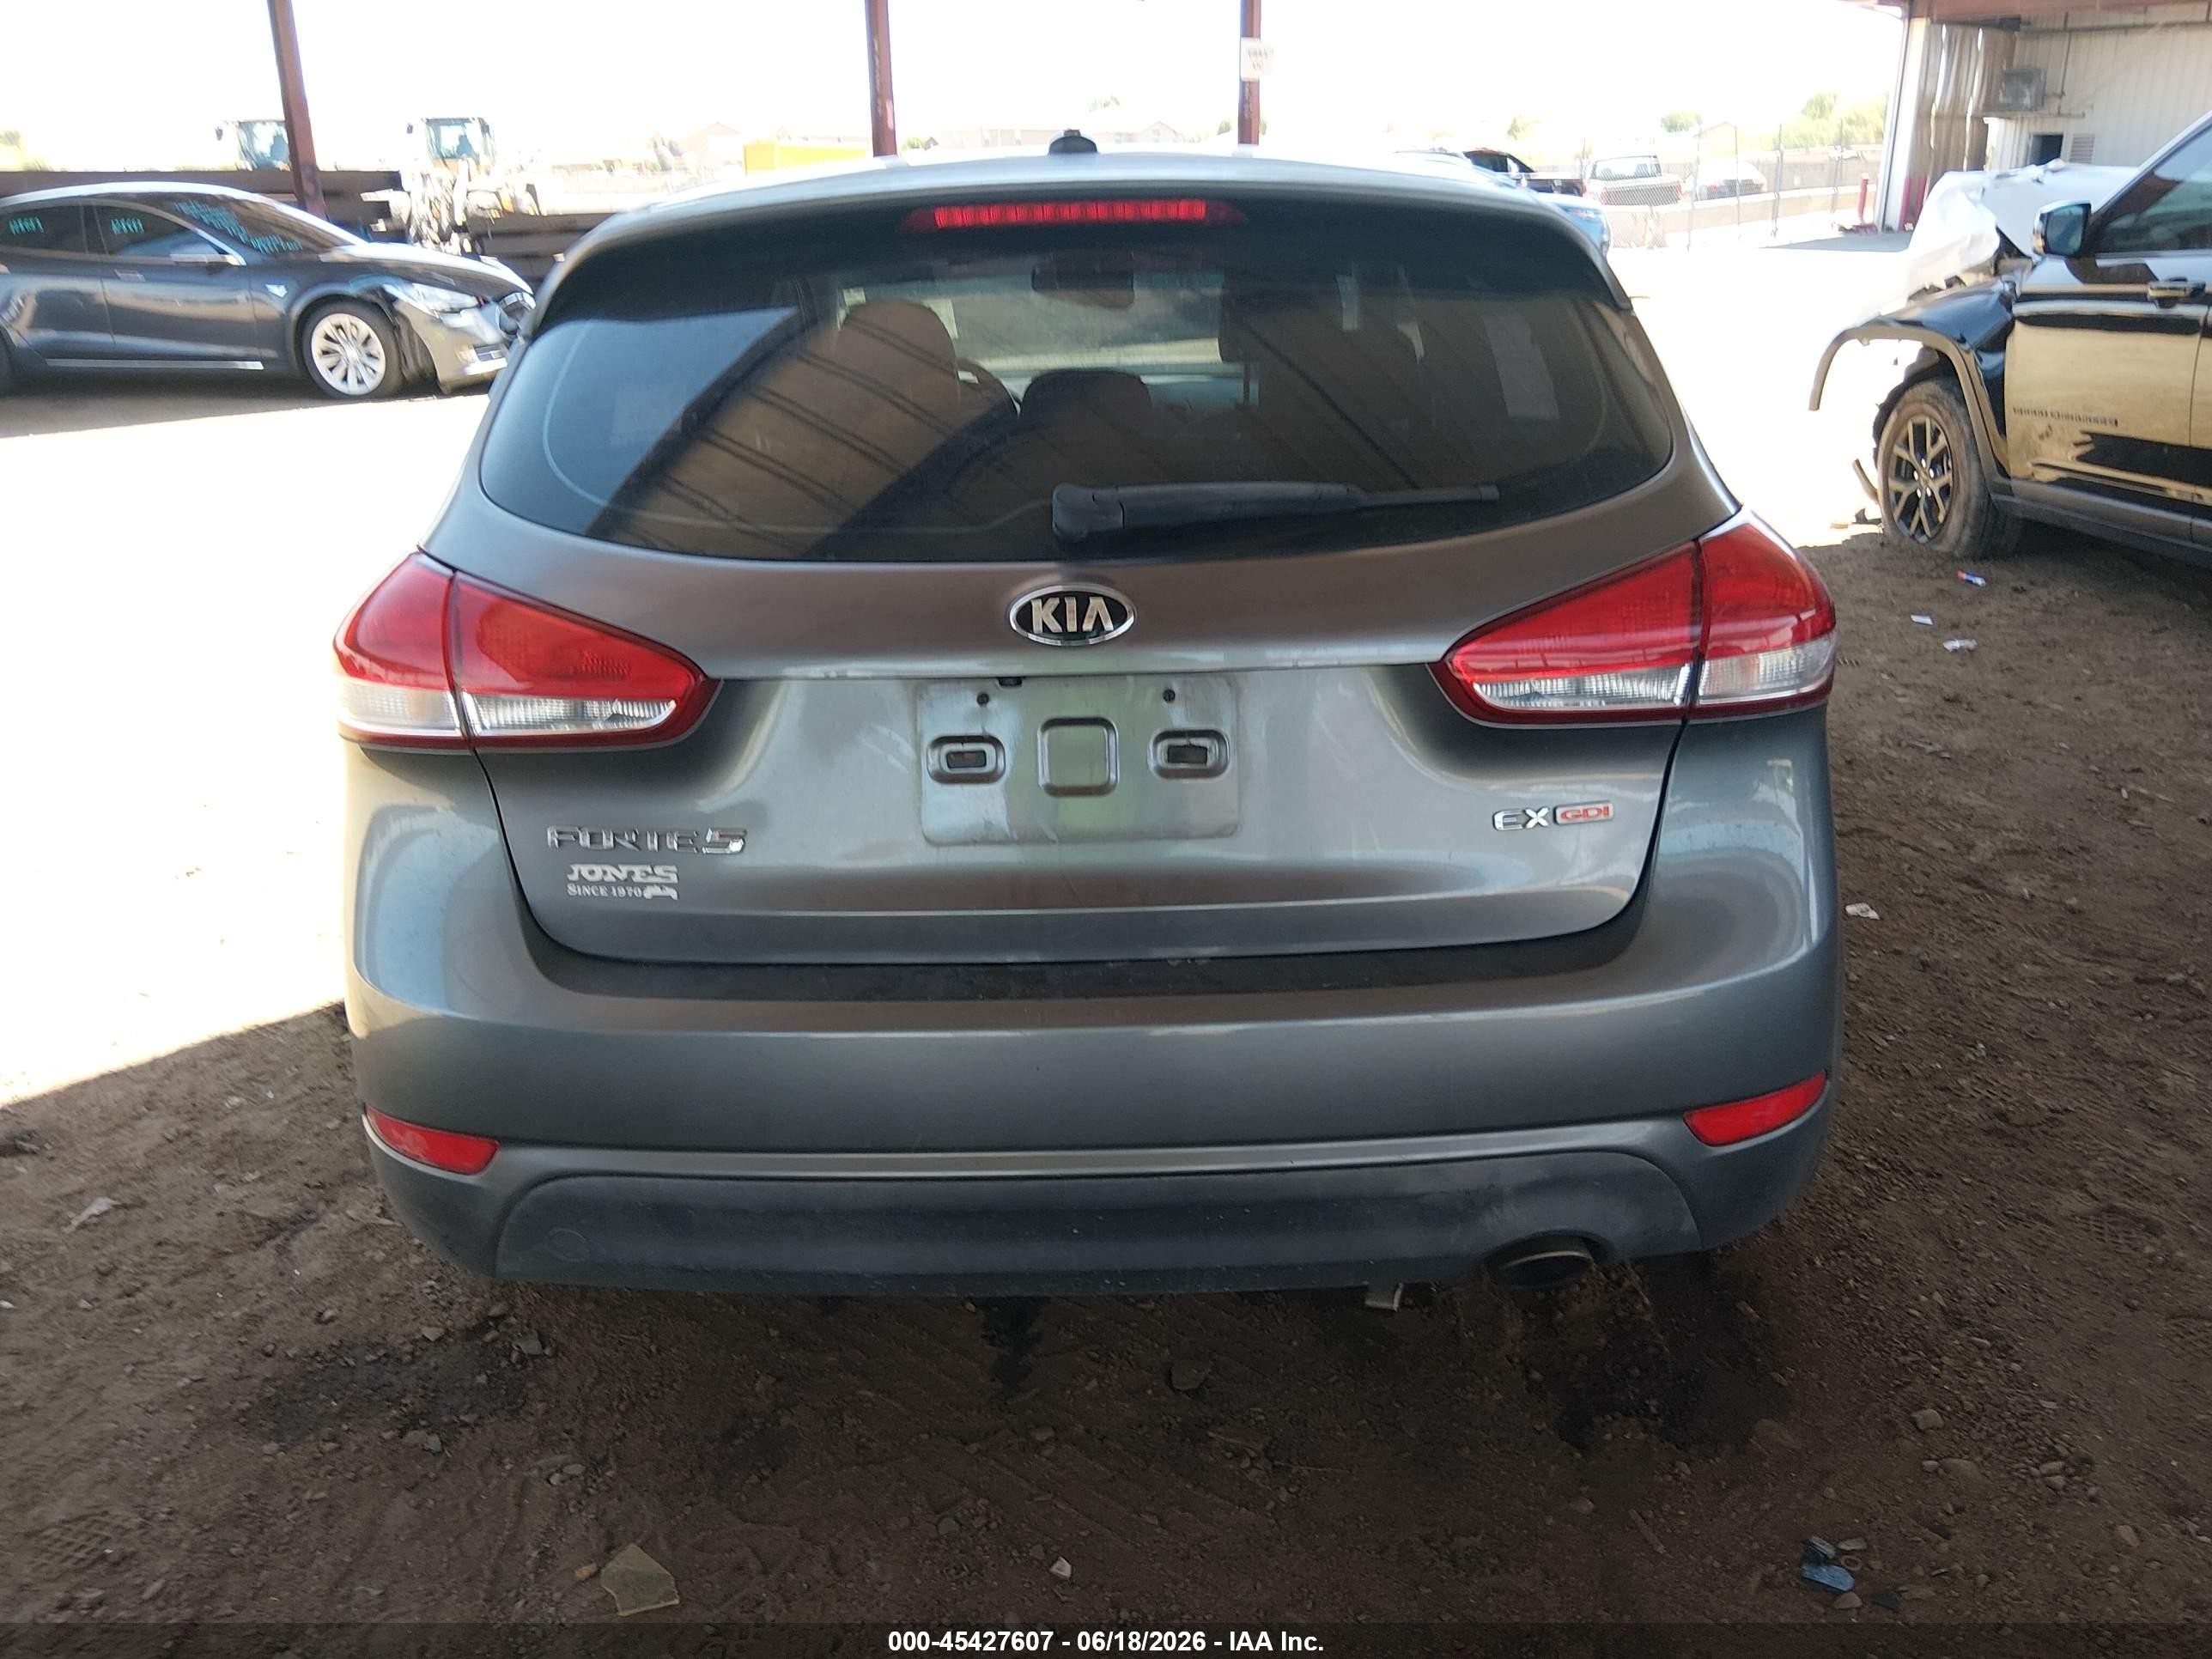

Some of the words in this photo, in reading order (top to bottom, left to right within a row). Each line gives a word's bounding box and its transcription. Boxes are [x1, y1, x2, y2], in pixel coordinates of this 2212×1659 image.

[1031, 597, 1114, 634] KIA
[1492, 807, 1550, 831] EX
[1560, 805, 1610, 820] GDI
[567, 864, 678, 883] JONES
